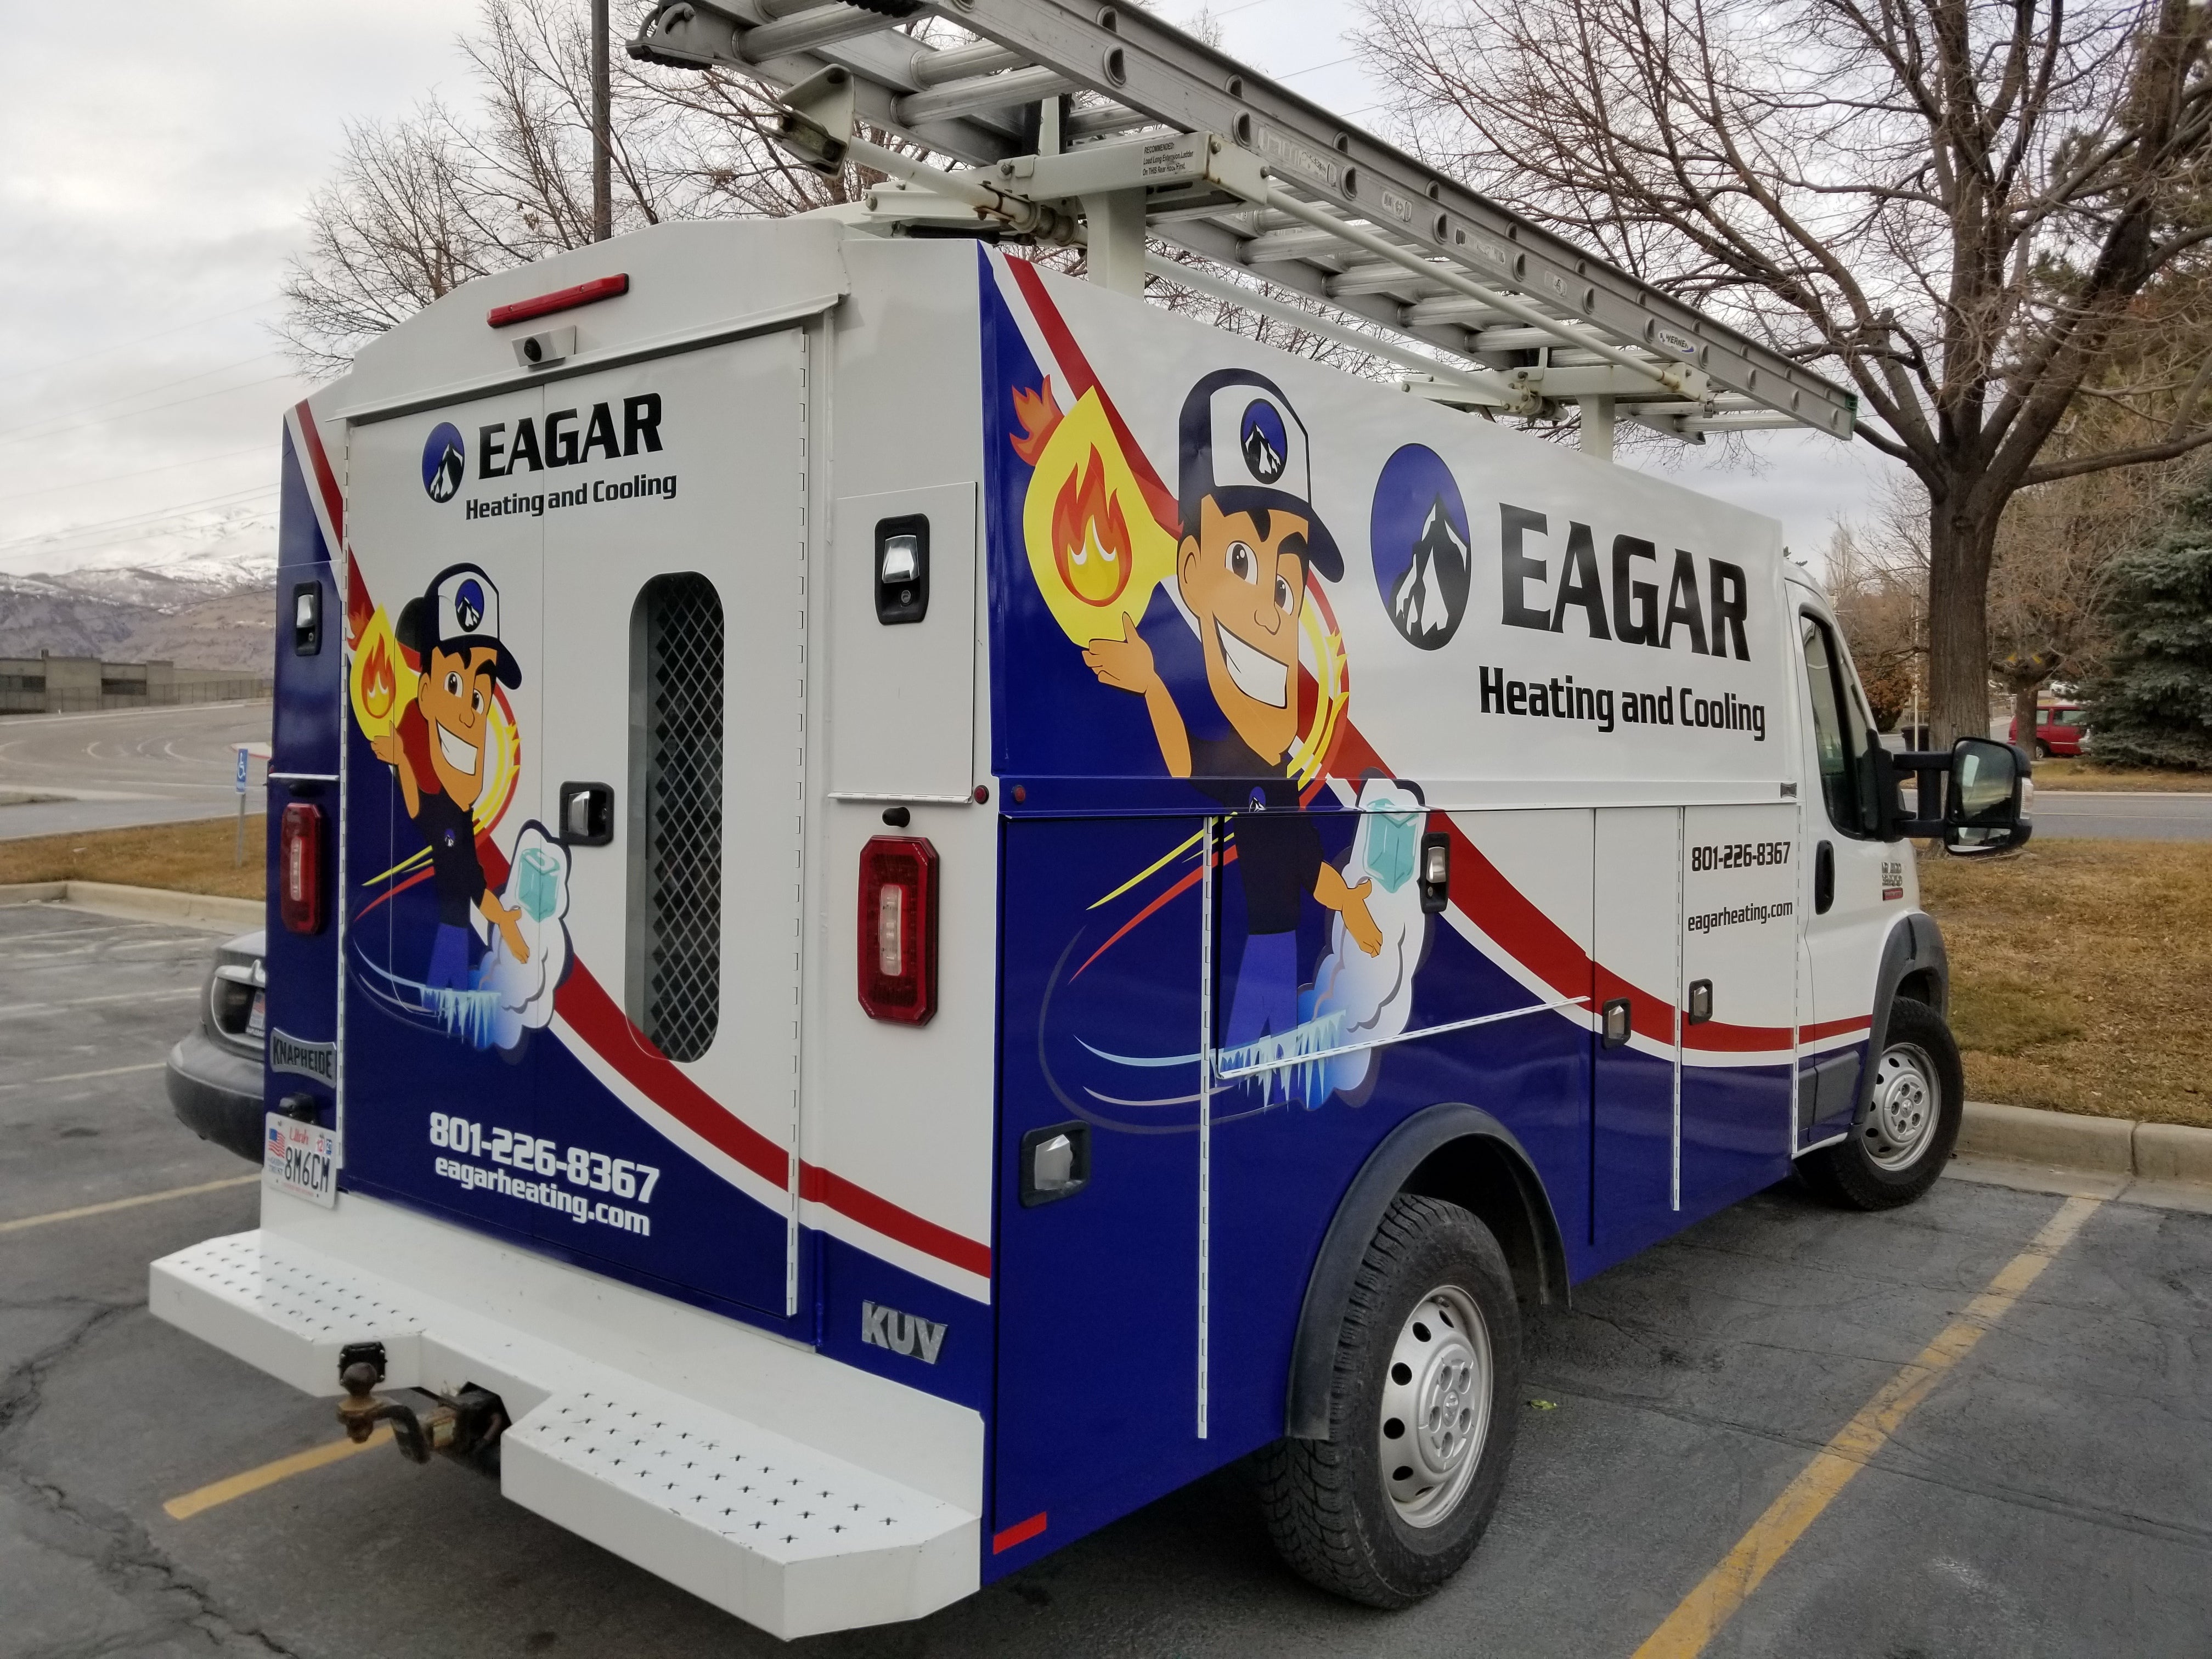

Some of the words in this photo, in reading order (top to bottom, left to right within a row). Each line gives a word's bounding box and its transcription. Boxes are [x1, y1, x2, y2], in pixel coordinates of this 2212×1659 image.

[1149, 167, 1157, 175] THIS
[478, 392, 663, 479] EAGAR
[465, 493, 544, 520] Heating
[548, 482, 588, 509] and
[592, 473, 678, 502] Cooling
[1499, 502, 1751, 662] EAGAR
[1478, 665, 1614, 733] Heating
[1622, 685, 1674, 725] and
[1680, 687, 1765, 742] Cooling
[1691, 841, 1791, 872] 801-226-8367
[1688, 901, 1793, 934] eagarheating.com
[272, 1036, 332, 1079] KNAPHEIDE
[289, 1126, 309, 1145] Utah
[429, 1111, 660, 1204] 801-226-8367
[435, 1156, 650, 1237] eagarheating.com
[861, 1299, 948, 1365] KUV
